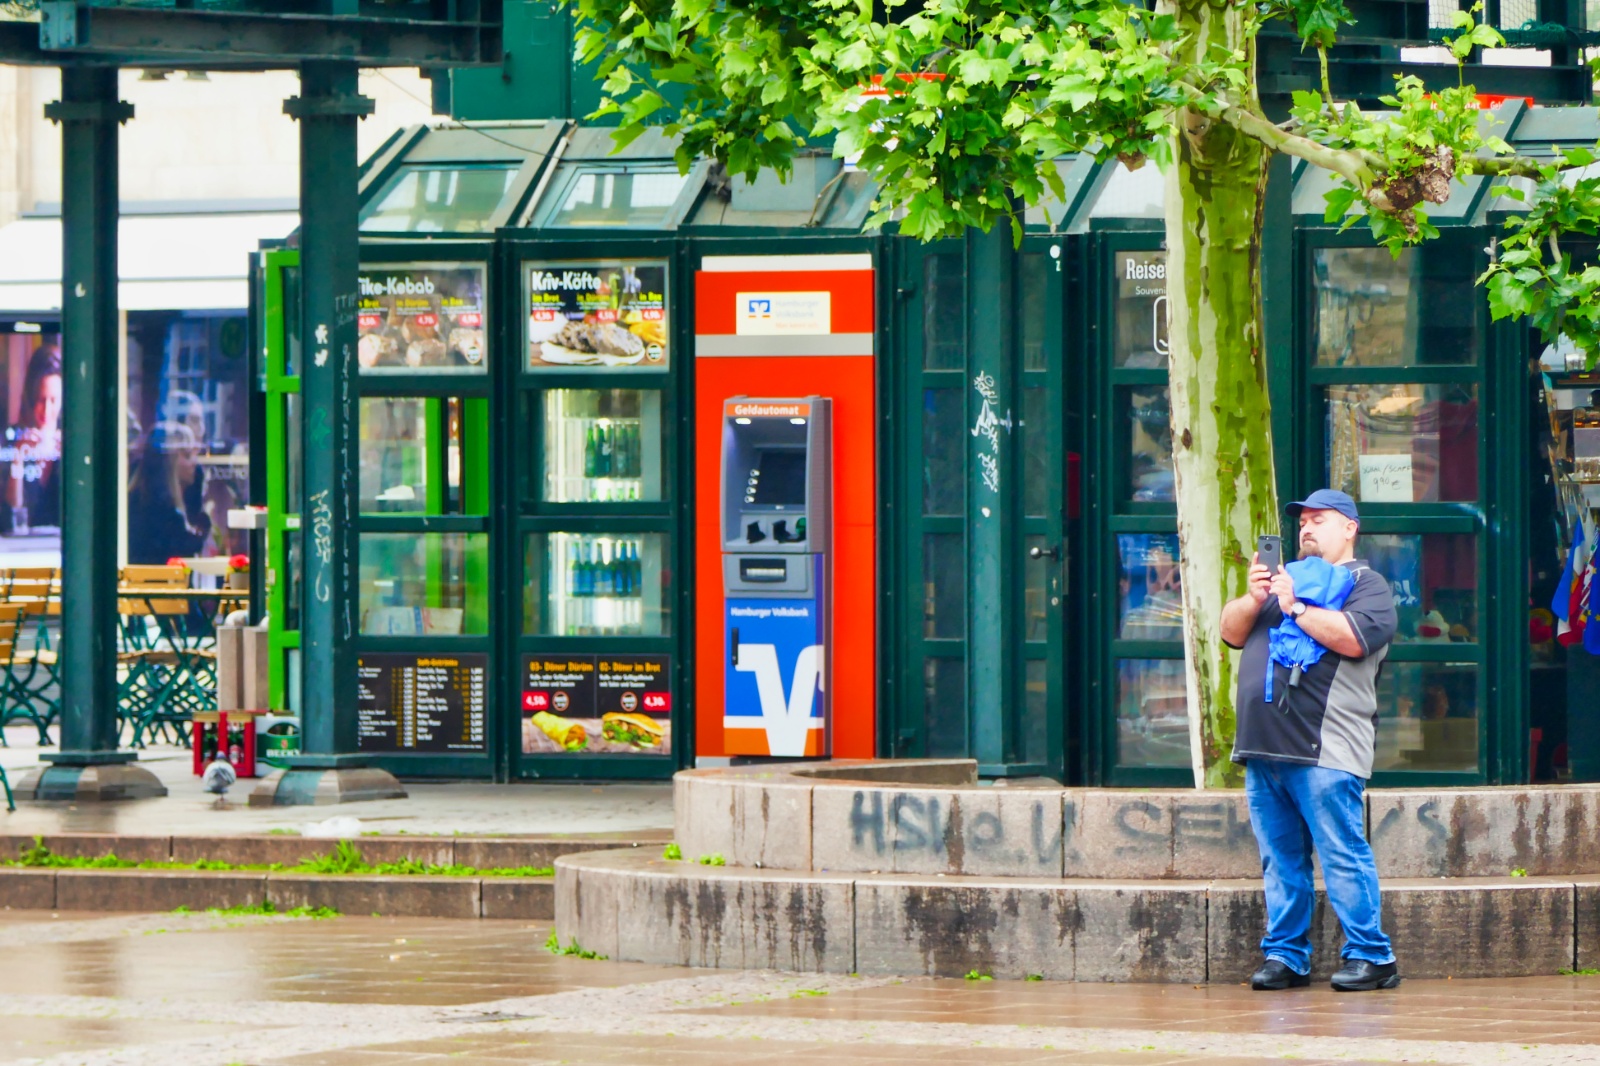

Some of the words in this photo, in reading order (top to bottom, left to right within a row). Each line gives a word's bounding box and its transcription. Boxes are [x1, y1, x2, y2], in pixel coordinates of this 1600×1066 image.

[1125, 258, 1167, 280] Reise
[734, 404, 799, 415] Geldautomat
[730, 606, 771, 619] Hamburger
[771, 606, 809, 617] Volksbank
